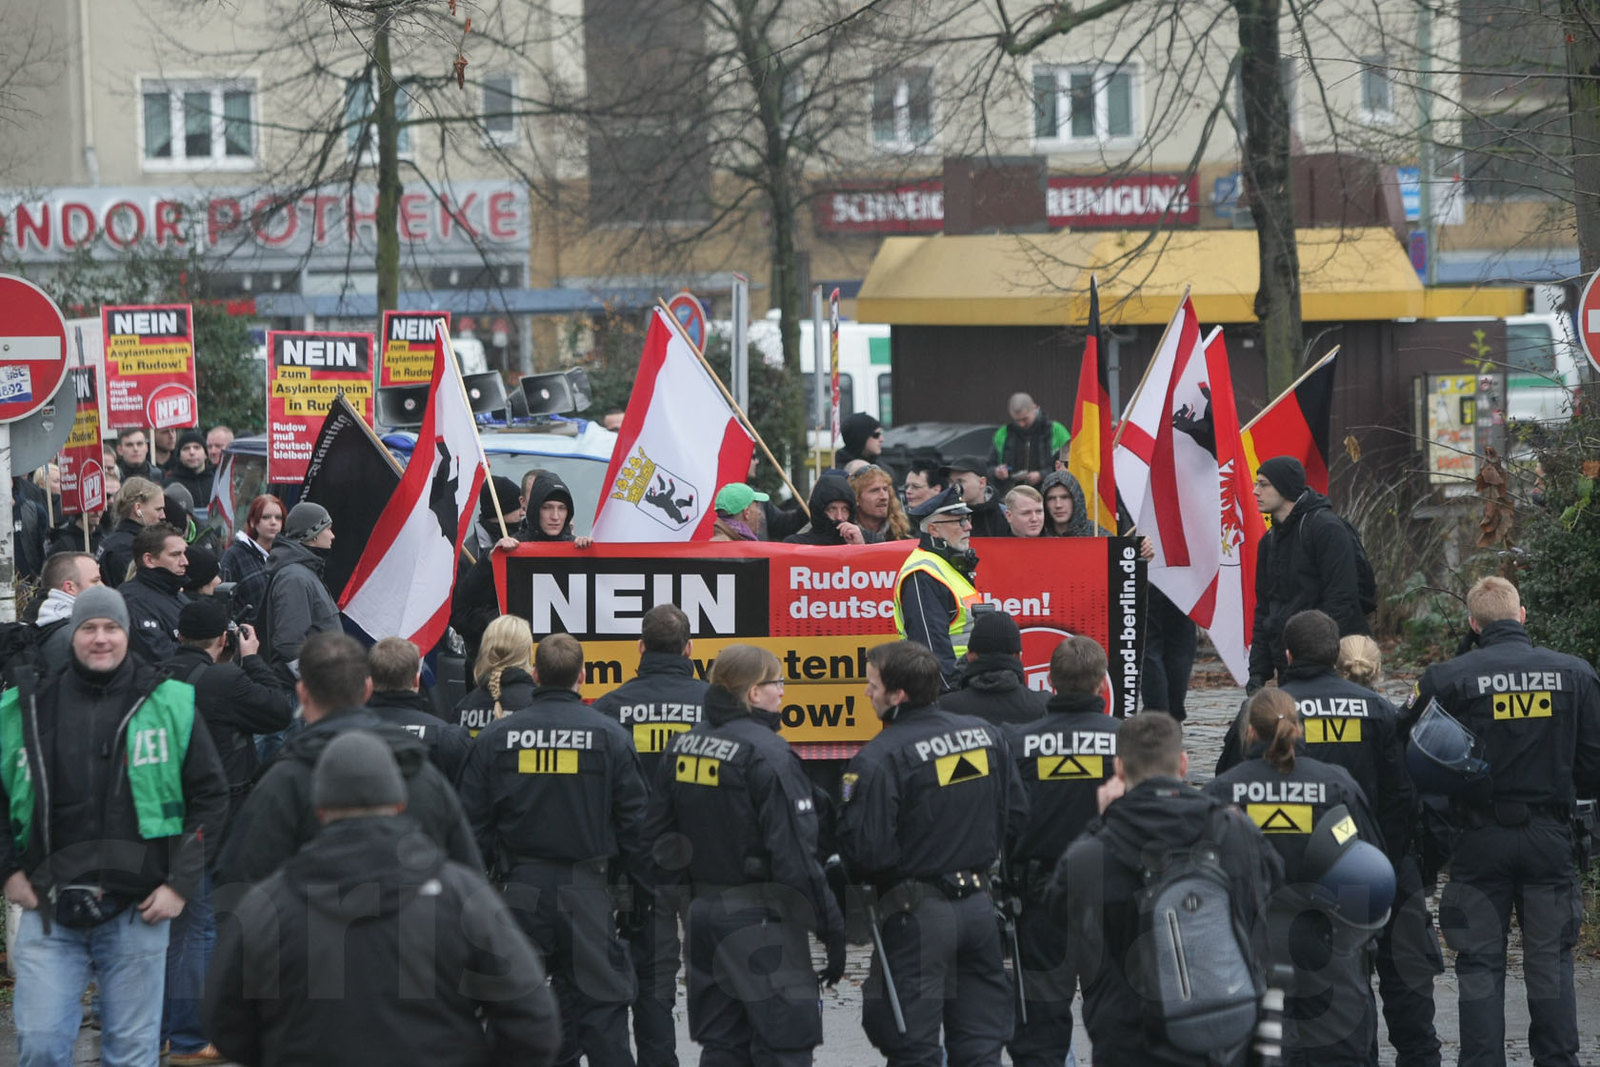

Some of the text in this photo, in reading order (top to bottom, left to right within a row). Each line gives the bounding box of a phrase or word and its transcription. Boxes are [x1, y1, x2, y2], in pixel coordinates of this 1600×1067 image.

[0, 199, 189, 250] NDOR
[113, 311, 178, 335] NEIN
[392, 318, 439, 340] NEIN
[110, 347, 188, 359] Asylantenheim
[113, 339, 137, 347] zum
[283, 339, 357, 367] NEIN
[122, 360, 182, 371] in Rudow!
[281, 371, 307, 379] zum
[275, 383, 369, 396] Asylantenheim
[156, 393, 190, 420] NPD
[289, 400, 303, 410] in
[272, 422, 307, 432] Rudow
[273, 432, 295, 441] muß
[273, 441, 313, 451] deutsch
[273, 450, 313, 460] bleiben!
[83, 476, 101, 501] NPD
[789, 566, 897, 590] Rudow
[532, 573, 736, 634] NEIN
[789, 597, 895, 619] deutsc
[1477, 672, 1562, 694] POLIZEI
[460, 708, 514, 728] POLI
[619, 703, 702, 724] POLIZEI
[781, 695, 856, 728] ow!
[506, 729, 593, 751] POLIZEI
[1322, 717, 1347, 741] IV
[672, 733, 741, 763] POLIZEI
[914, 728, 993, 763] POLIZEI
[1024, 731, 1117, 757] POLIZEI
[1232, 781, 1326, 804] POLIZEI
